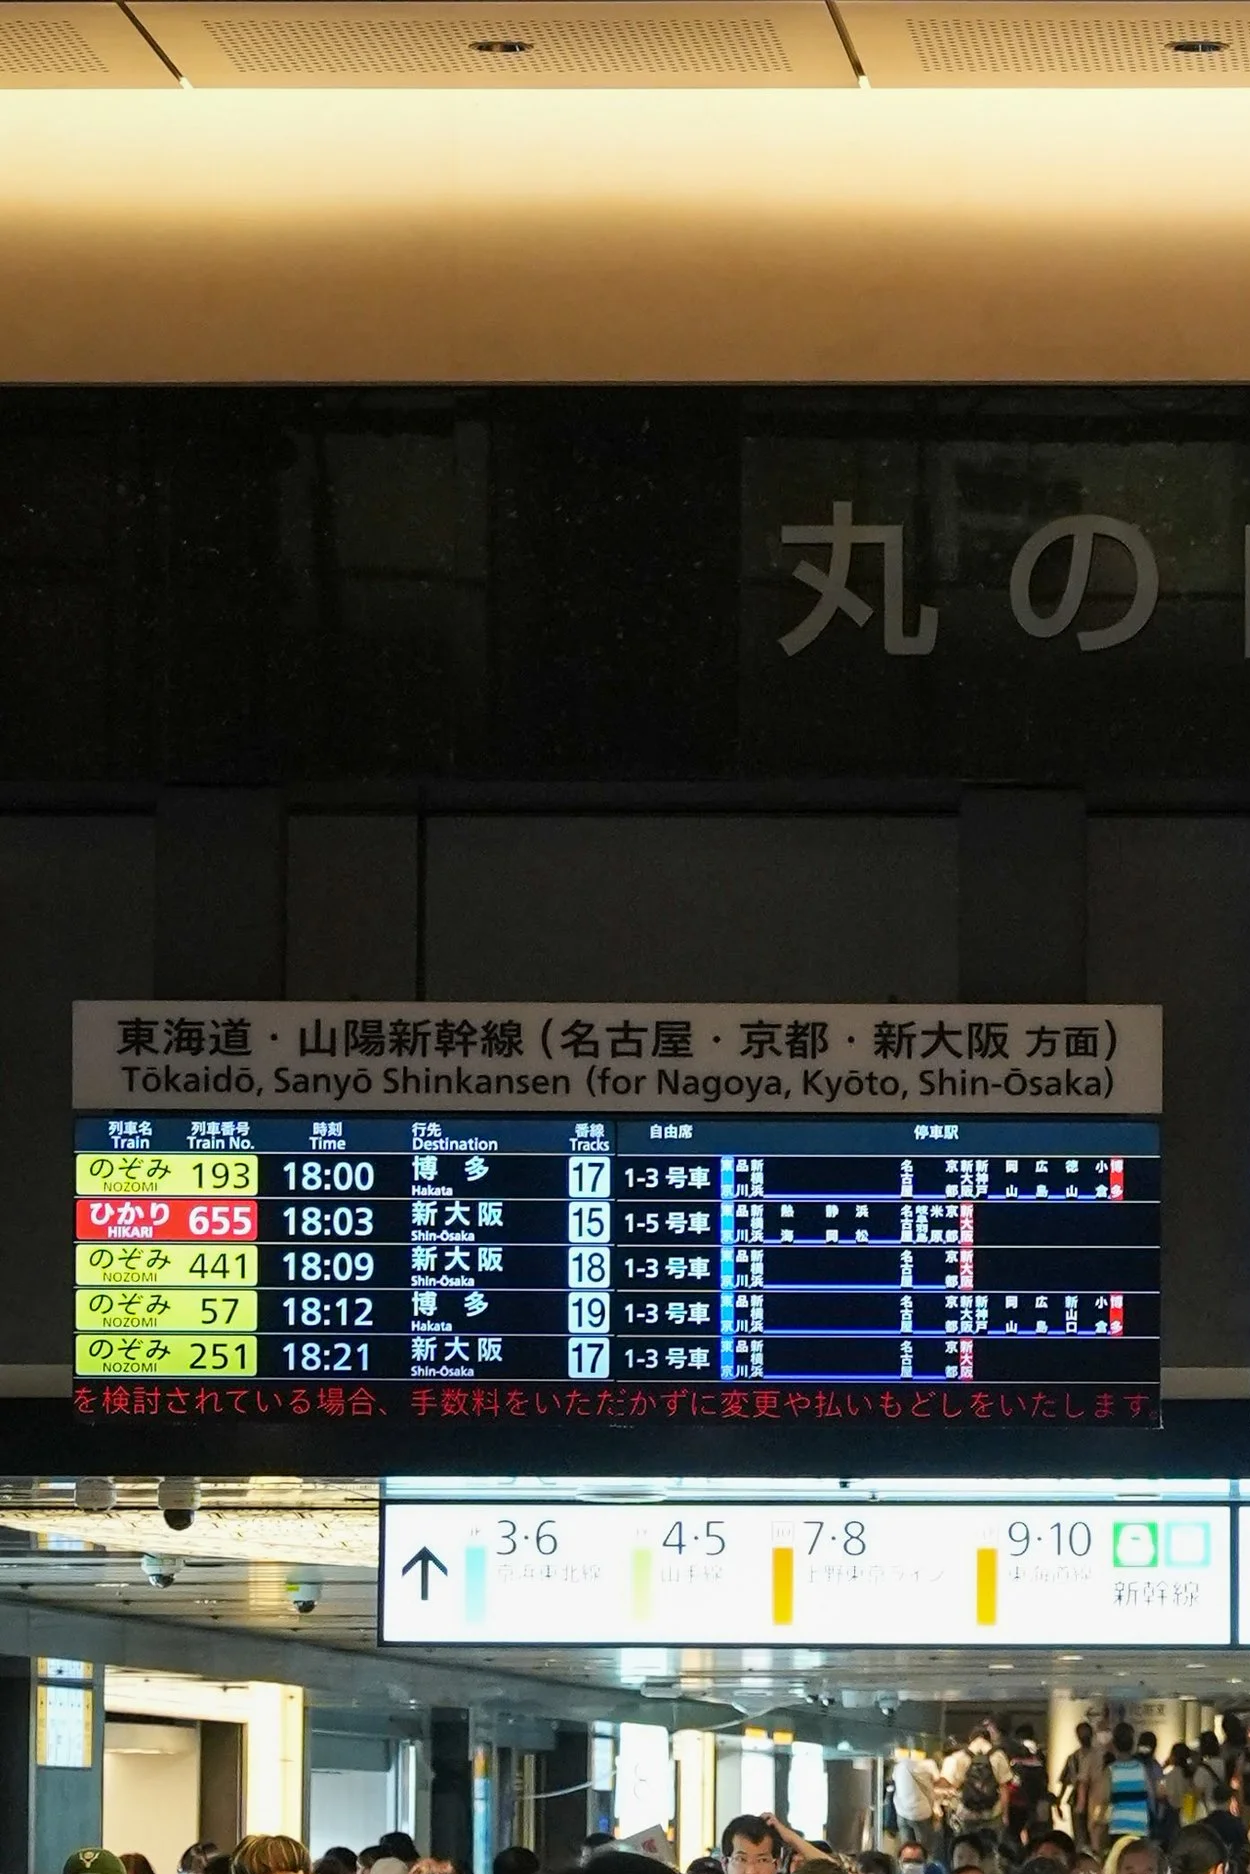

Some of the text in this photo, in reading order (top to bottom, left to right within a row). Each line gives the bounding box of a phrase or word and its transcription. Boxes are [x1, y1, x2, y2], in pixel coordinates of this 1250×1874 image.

[384, 1066, 570, 1094] Shinkansen
[587, 1065, 647, 1097] (for
[658, 1069, 790, 1102] Nagoya,
[109, 1121, 152, 1135] 列車名
[191, 1121, 250, 1138] 列車番号
[313, 1122, 342, 1136] 時刻
[412, 1122, 441, 1140] 行先
[572, 1123, 604, 1141] 番線
[651, 1124, 693, 1139] 自由席
[914, 1125, 958, 1139] 停車駅
[111, 1136, 149, 1149] Train
[187, 1134, 254, 1149] Train No.
[309, 1137, 346, 1150] Time
[413, 1135, 497, 1150] Destination
[569, 1136, 609, 1151] Tracks
[90, 1155, 710, 1192] のぞみ 193 18:00 博多 17 1-3 号車
[103, 1182, 158, 1192] NOZOMI
[412, 1185, 453, 1196] Hakata
[90, 1201, 710, 1237] ひかり 655 18:03 新大阪 15 1-5 号車
[108, 1226, 152, 1238] HIKARI
[90, 1246, 604, 1282] のぞみ 441 18:09 新大阪 18
[103, 1272, 158, 1283] NOZOMI
[90, 1291, 604, 1327] のぞみ 57 18:12 博多 19
[103, 1317, 158, 1328] NOZOMI
[412, 1320, 452, 1331] Hakata
[89, 1336, 604, 1373] のぞみ 251 18:21 新大阪 17
[103, 1363, 158, 1373] NOZOMI
[1114, 1582, 1200, 1607] 新幹線
